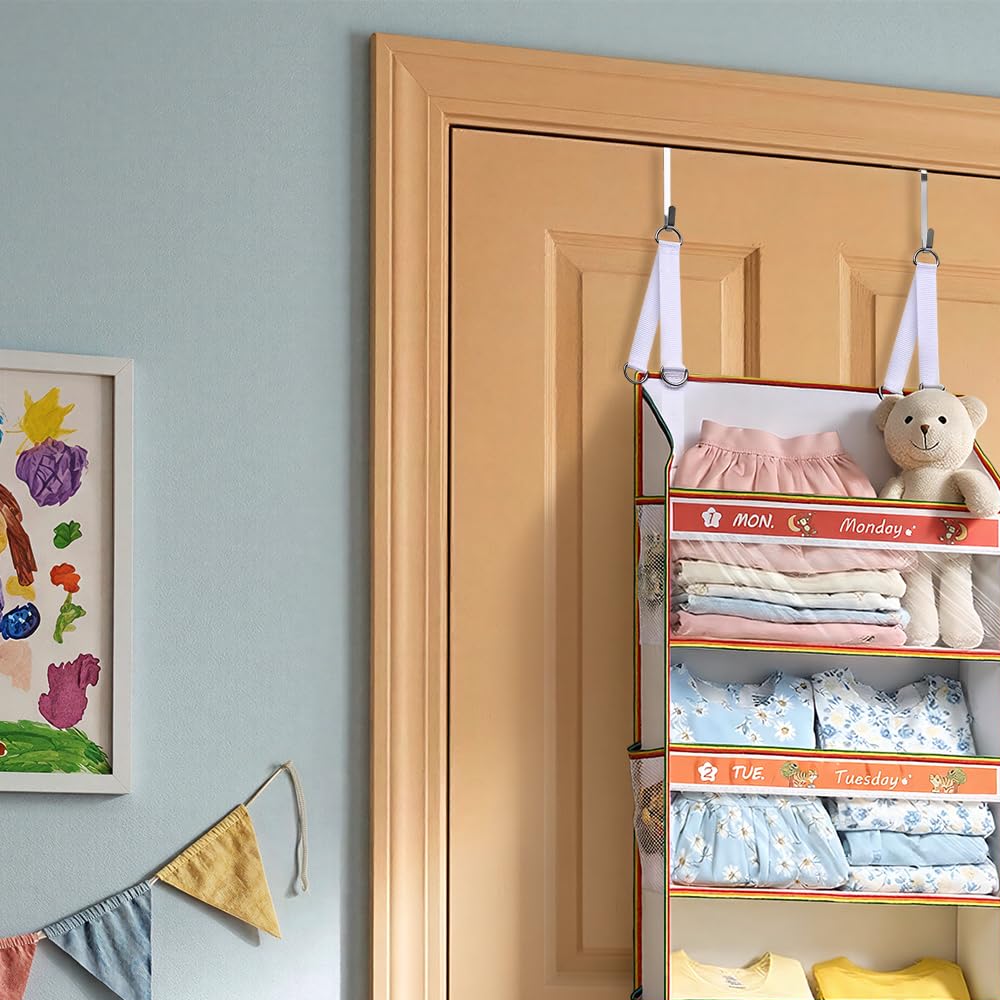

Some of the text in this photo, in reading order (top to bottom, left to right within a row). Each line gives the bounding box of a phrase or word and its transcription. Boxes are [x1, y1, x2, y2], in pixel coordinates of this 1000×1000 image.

[732, 512, 775, 529] MON.
[839, 517, 903, 538] Monday
[732, 765, 765, 780] TUE.
[834, 769, 900, 790] Tuesday
